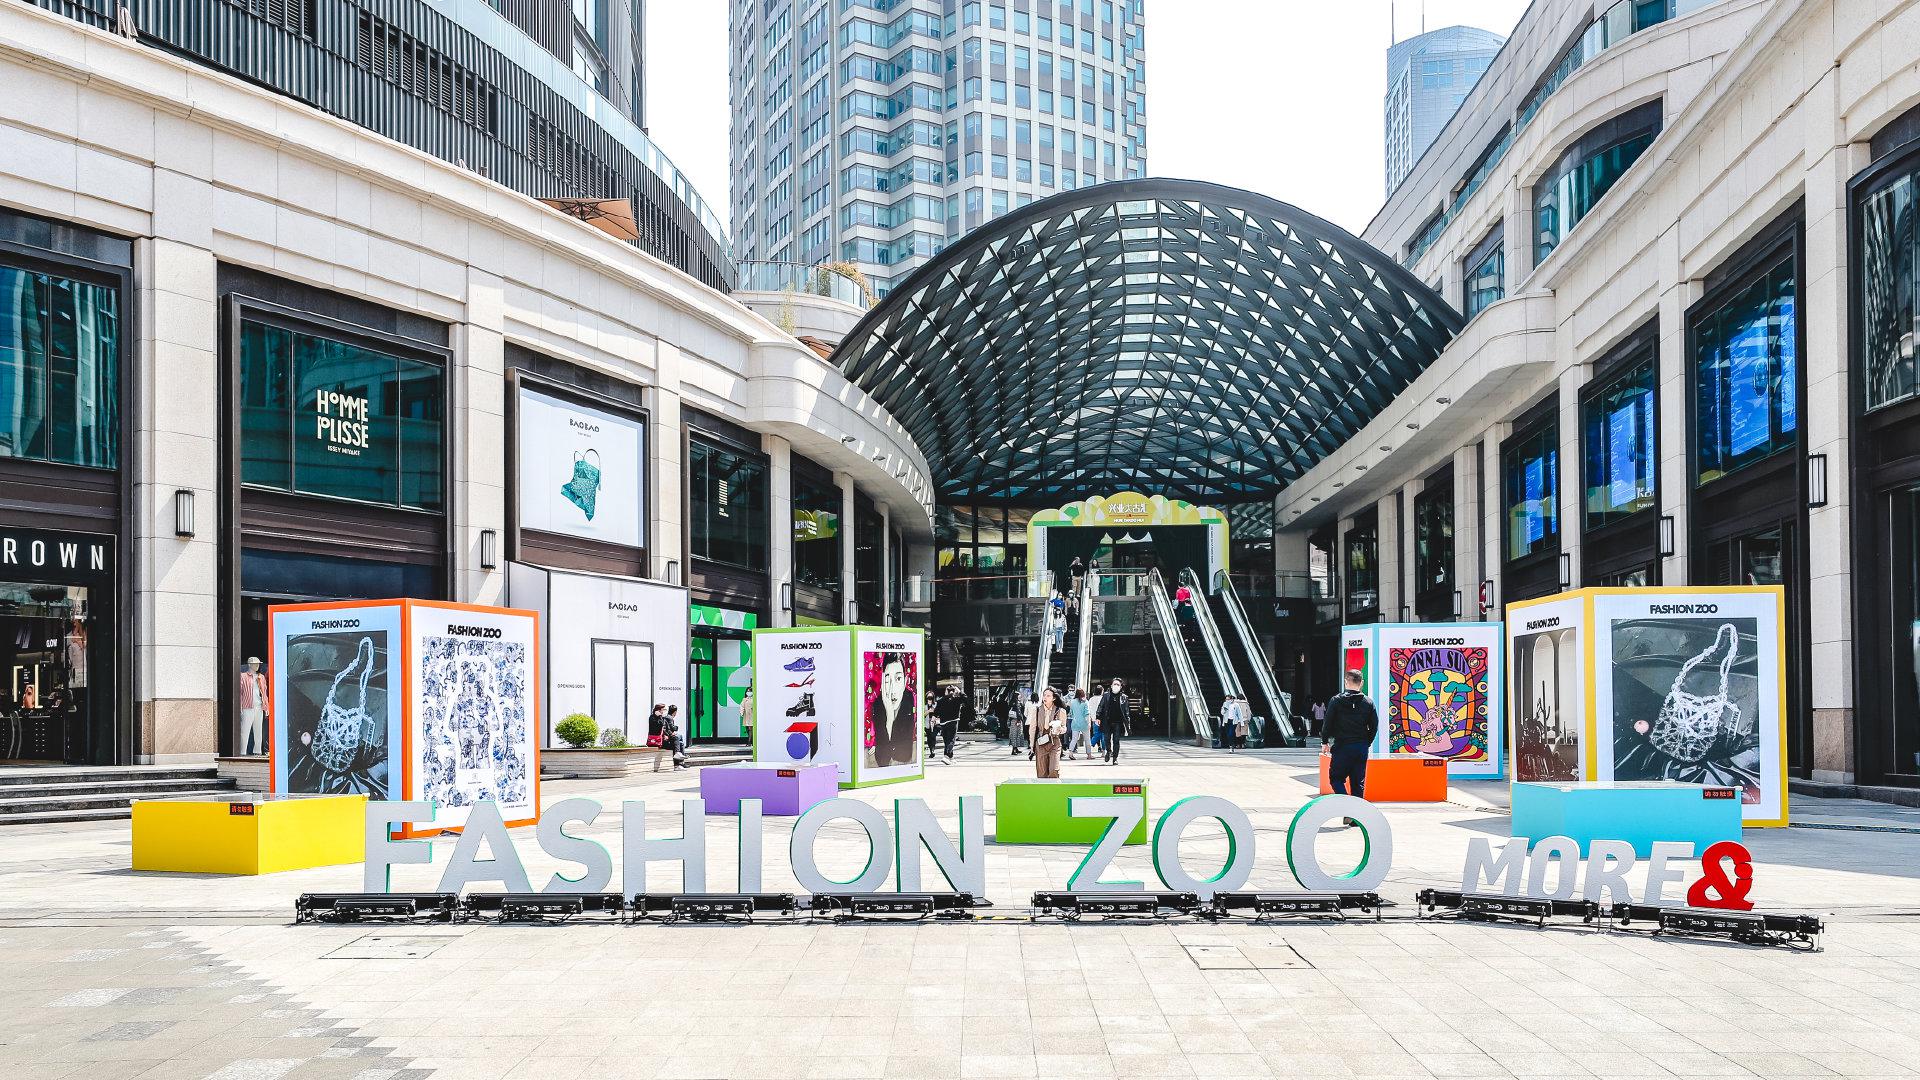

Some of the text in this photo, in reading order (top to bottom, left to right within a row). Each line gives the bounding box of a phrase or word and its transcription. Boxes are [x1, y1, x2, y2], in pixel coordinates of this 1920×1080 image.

[317, 389, 369, 422] HOMME
[1648, 603, 1719, 614] FASHION ZOO
[311, 619, 360, 630] FASHION ZOO
[1526, 616, 1560, 631] FASHION ZOO
[447, 624, 502, 639] FASHION ZOO
[780, 642, 823, 650] FASHION ZOO
[875, 642, 895, 650] FASHION
[1412, 637, 1465, 646] FASHION ZOO
[1410, 649, 1466, 676] ANNA SUI
[363, 794, 1393, 898] FASHION ZOO
